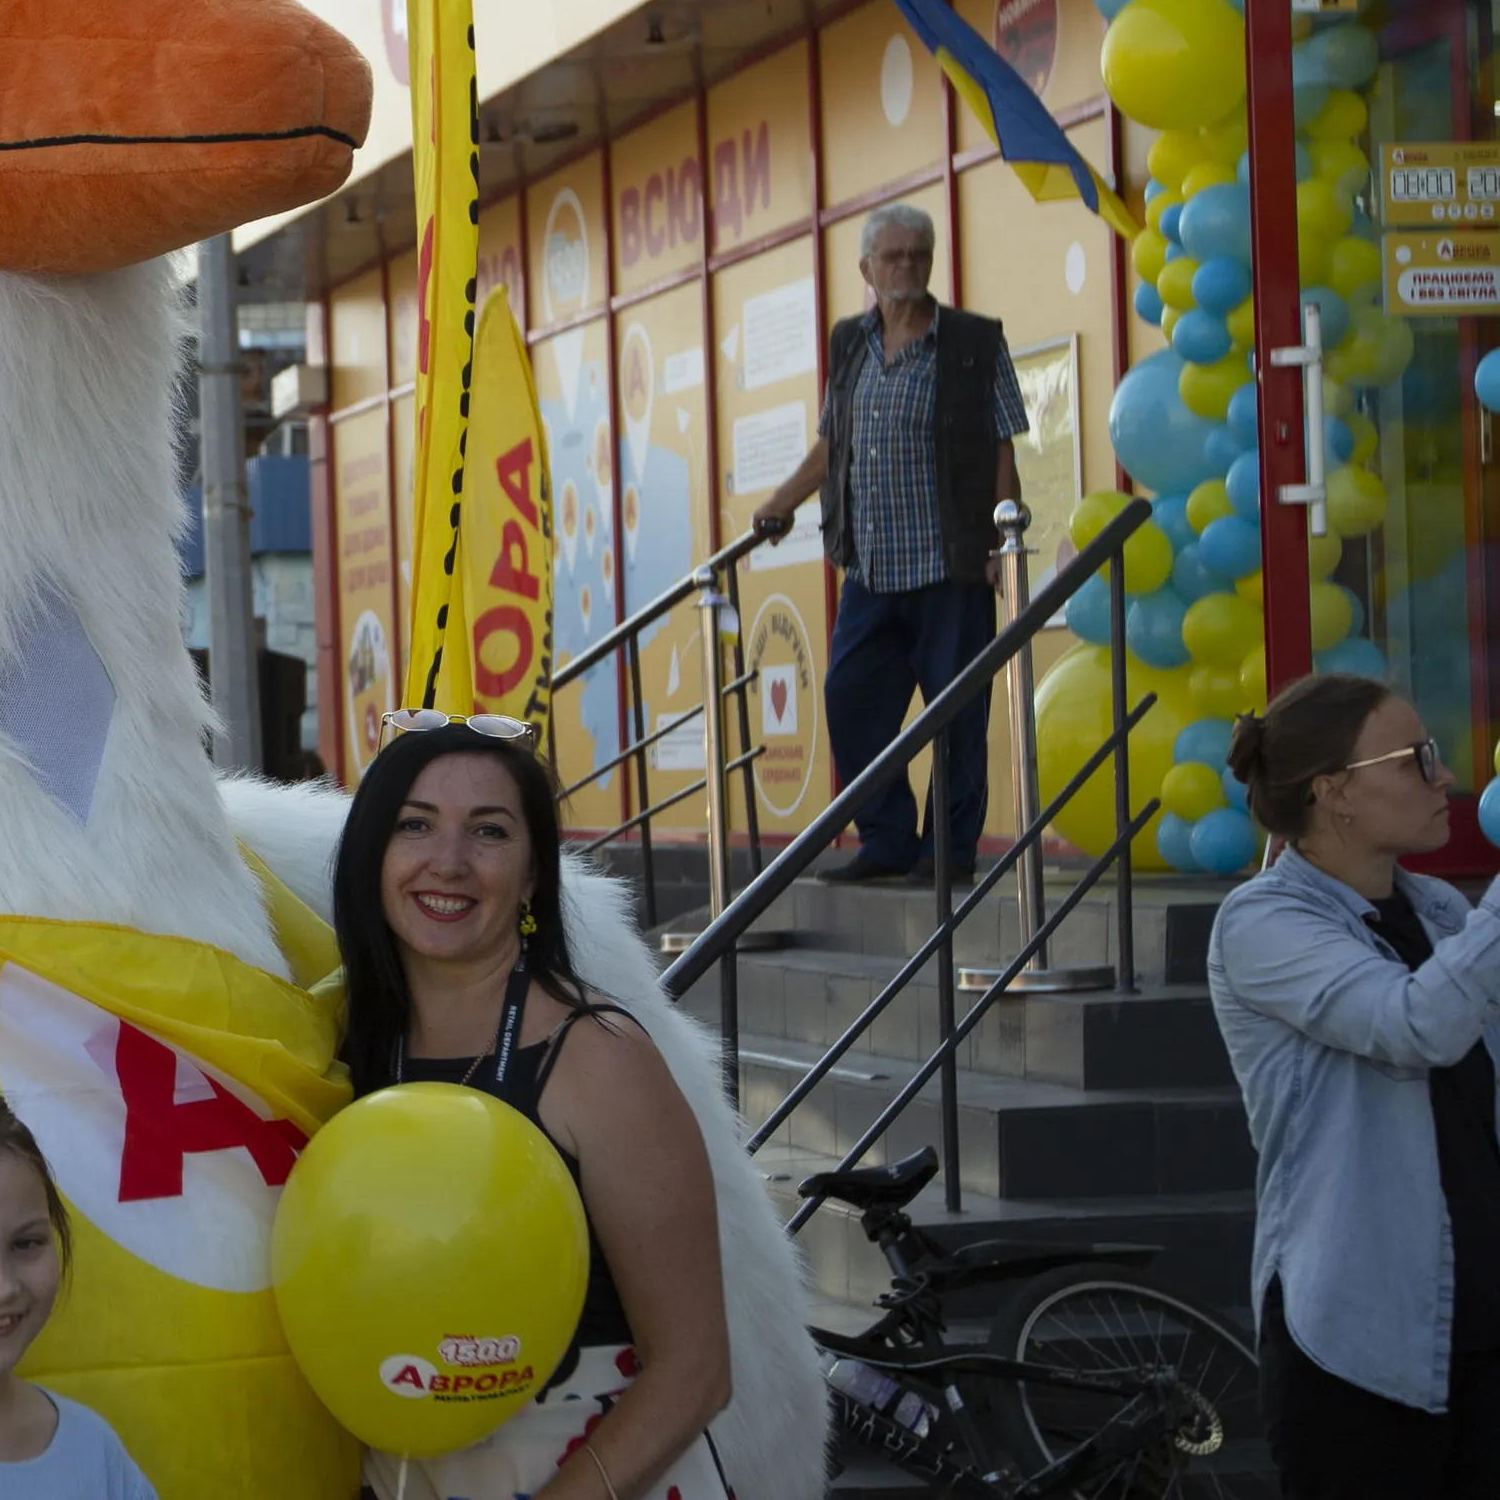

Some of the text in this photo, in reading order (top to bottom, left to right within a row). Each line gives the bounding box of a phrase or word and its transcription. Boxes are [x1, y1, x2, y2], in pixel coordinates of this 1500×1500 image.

[619, 120, 771, 270] ВСЮДИ
[473, 436, 542, 716] ОРА
[496, 1005, 517, 1082] RETAIL DEPARTMENT
[391, 1364, 534, 1393] АВРОРА
[439, 1336, 519, 1363] 1500
